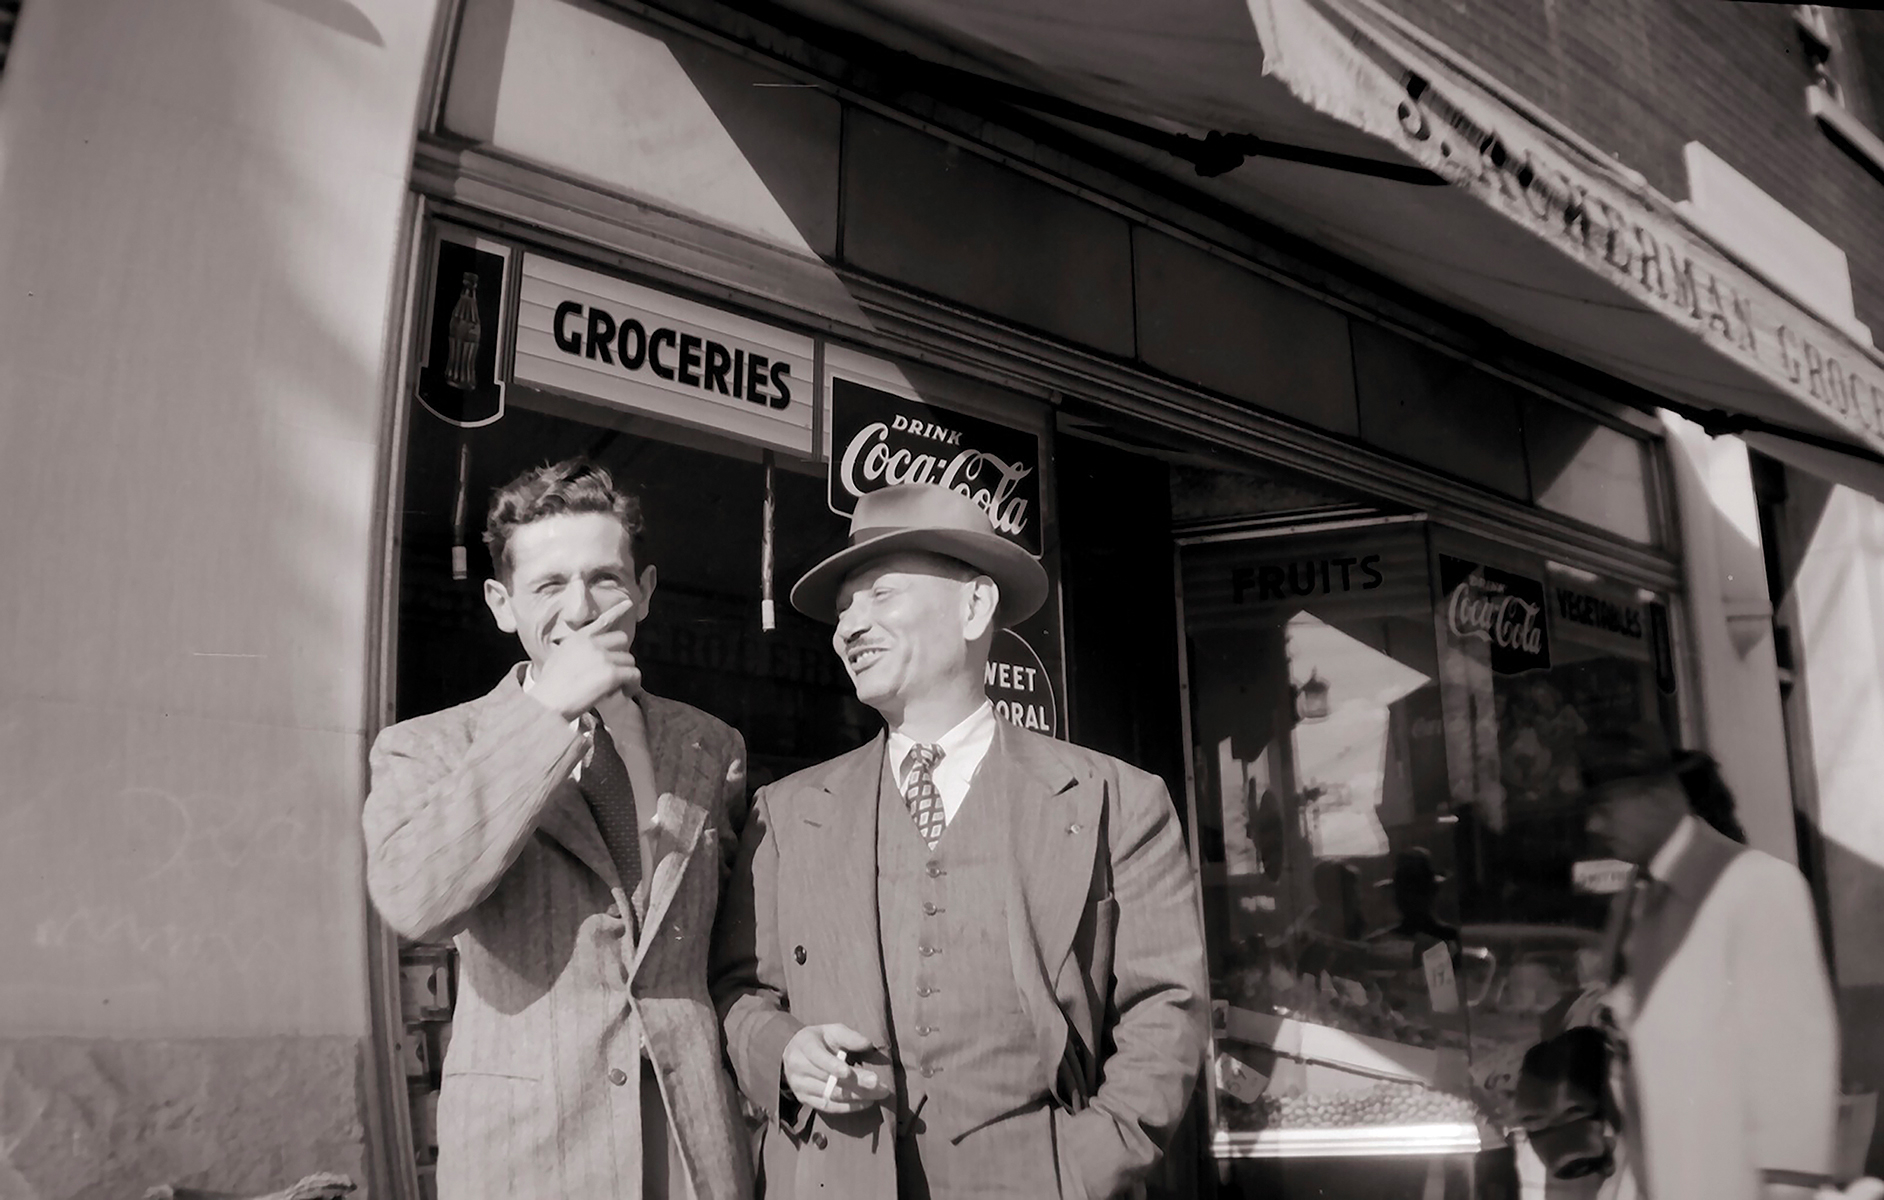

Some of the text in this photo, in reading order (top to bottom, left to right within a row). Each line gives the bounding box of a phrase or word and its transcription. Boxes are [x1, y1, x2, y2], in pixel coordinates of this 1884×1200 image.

[553, 300, 791, 411] GROCERIES
[891, 413, 963, 446] DRINK
[1232, 554, 1383, 604] FRUITS
[1448, 582, 1542, 655] Coca-Cola
[984, 660, 1037, 692] WEET
[996, 700, 1050, 731] ORAL
